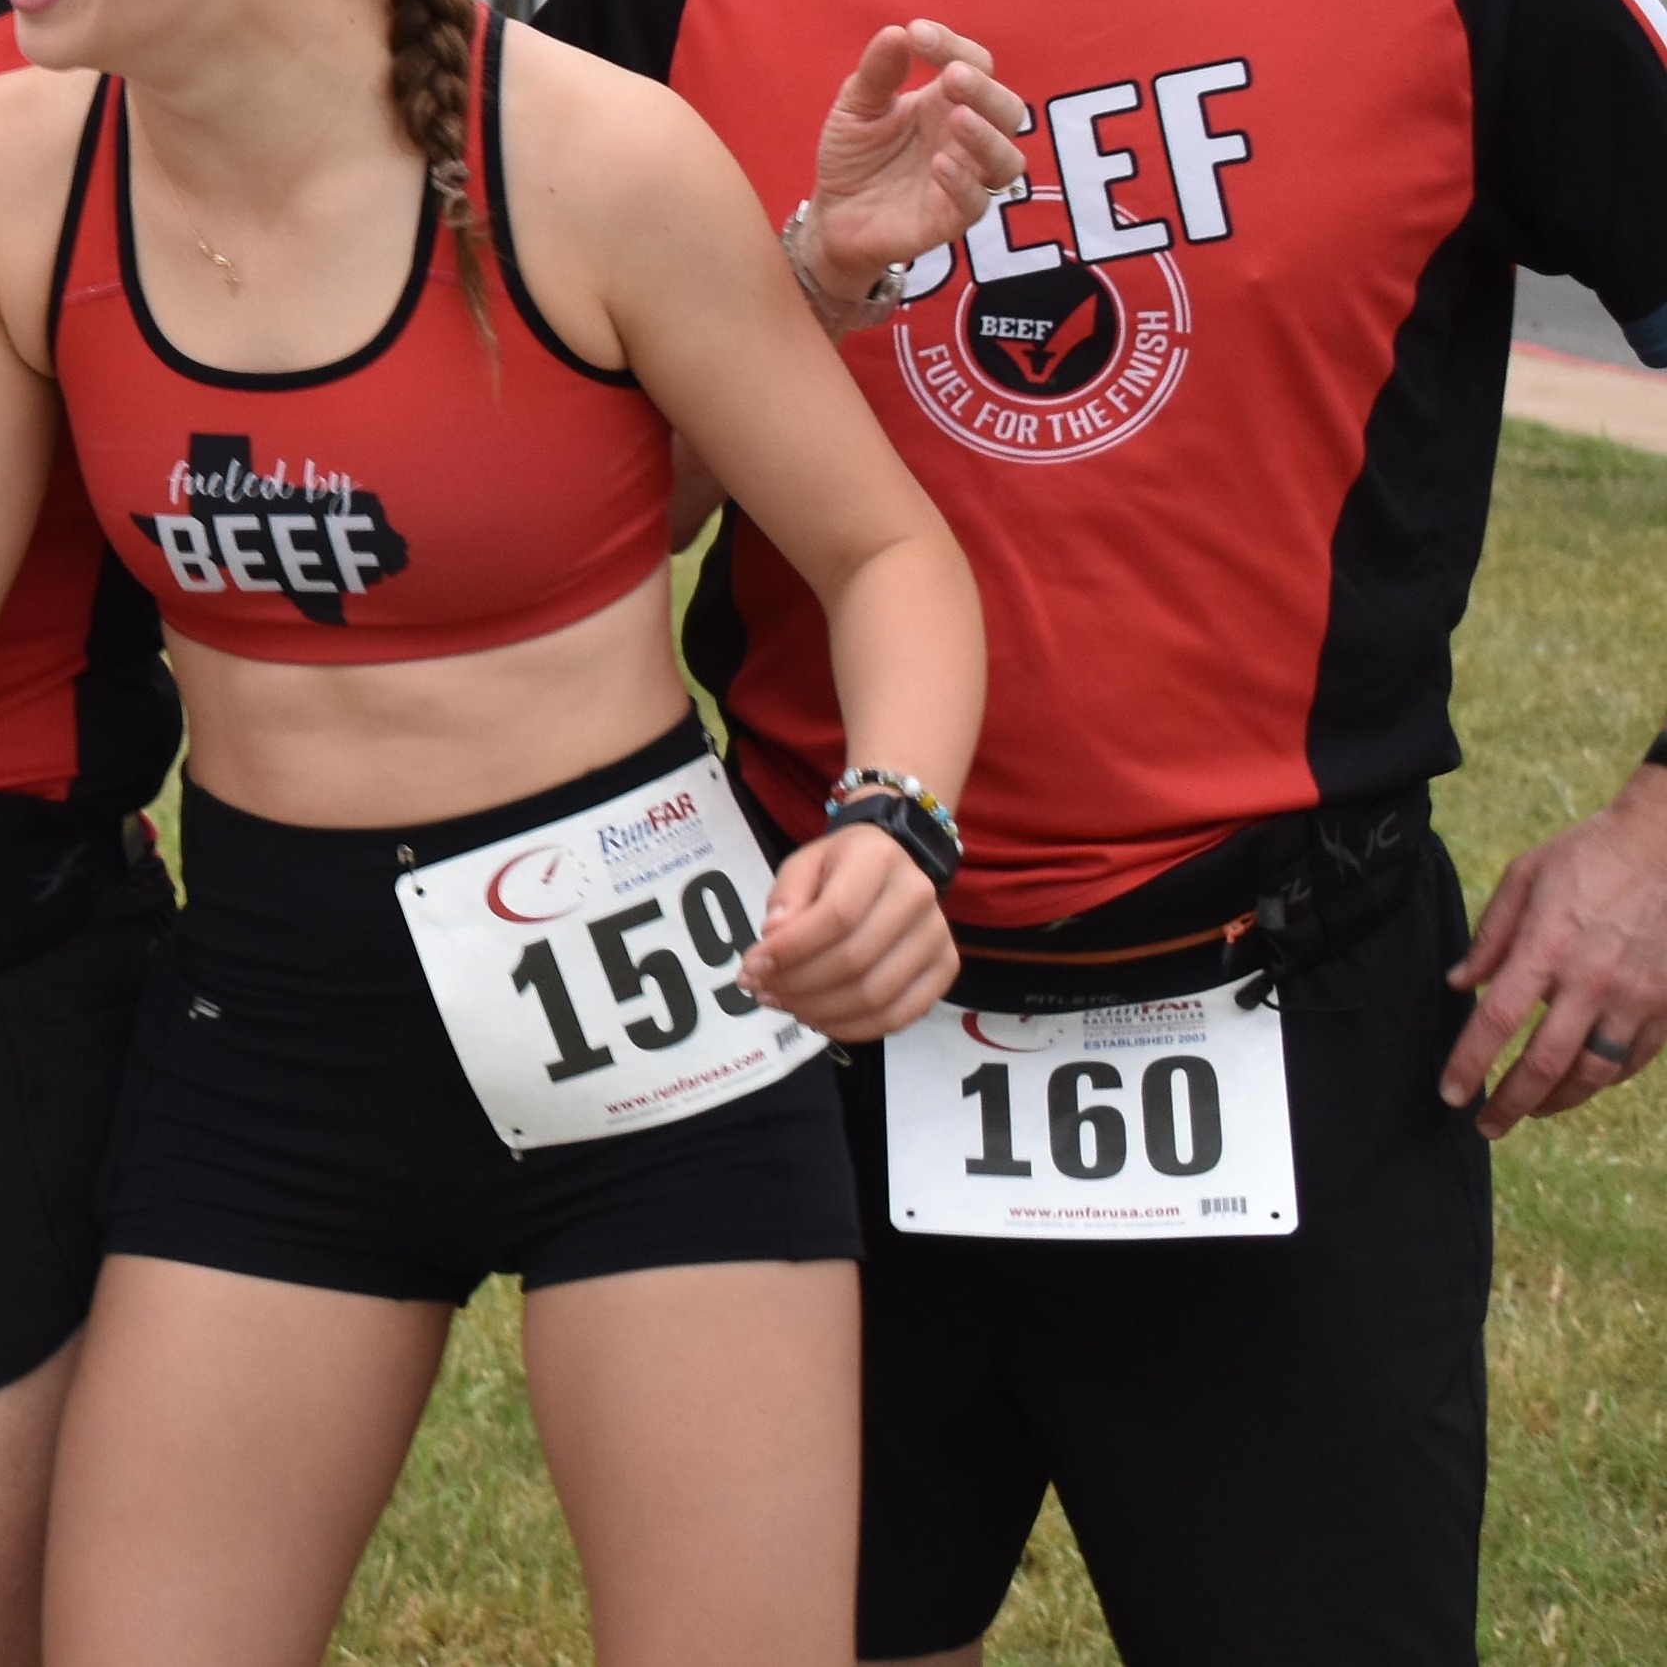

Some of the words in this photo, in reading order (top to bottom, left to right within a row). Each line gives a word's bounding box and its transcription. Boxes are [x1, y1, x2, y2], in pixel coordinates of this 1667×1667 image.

[979, 315, 1055, 341] BEEF
[917, 344, 975, 417] FUEL
[973, 401, 1040, 444] FOR
[1046, 399, 1113, 443] THE
[1104, 310, 1169, 415] FINISH
[168, 457, 296, 506] fueled
[303, 458, 363, 517] by
[154, 513, 380, 595] BEEF
[597, 792, 698, 854] RunFAR
[510, 869, 761, 1085] 159
[1083, 1037, 1174, 1051] ESTABLISHED
[1178, 1033, 1207, 1044] 2003
[1140, 1011, 1205, 1022] SERVICES
[961, 1055, 1223, 1180] 160
[1009, 1206, 1180, 1220] www.runfarusa.com
